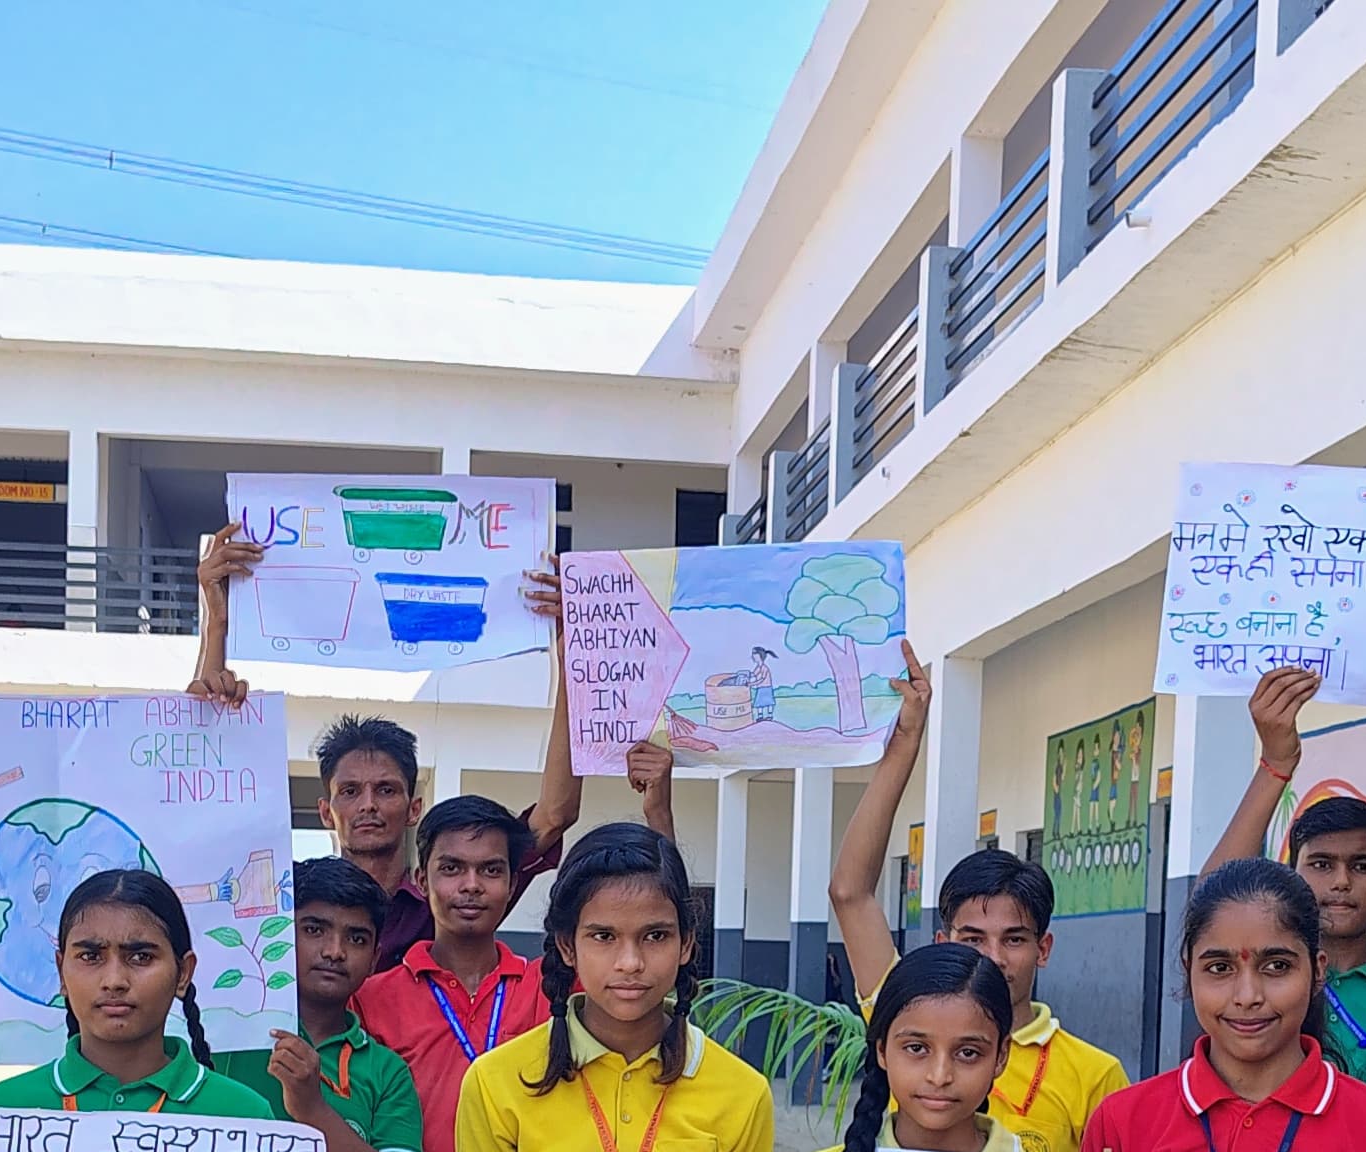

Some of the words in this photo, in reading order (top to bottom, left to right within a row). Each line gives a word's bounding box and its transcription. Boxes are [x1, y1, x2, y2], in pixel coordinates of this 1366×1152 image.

[243, 506, 325, 549] USE
[448, 500, 515, 549] ME
[564, 564, 634, 594] SWACHH
[567, 602, 640, 623] BHARAT
[569, 628, 657, 651] ABHIYAN
[572, 659, 645, 683] SLOGAN
[1193, 644, 1249, 675] भारत
[22, 701, 121, 729] BHARAT
[145, 699, 264, 727] ABHIYAN
[592, 689, 627, 712] IN
[580, 720, 638, 744] HINDI
[131, 733, 222, 767] GREEN
[159, 768, 257, 803] INDIA
